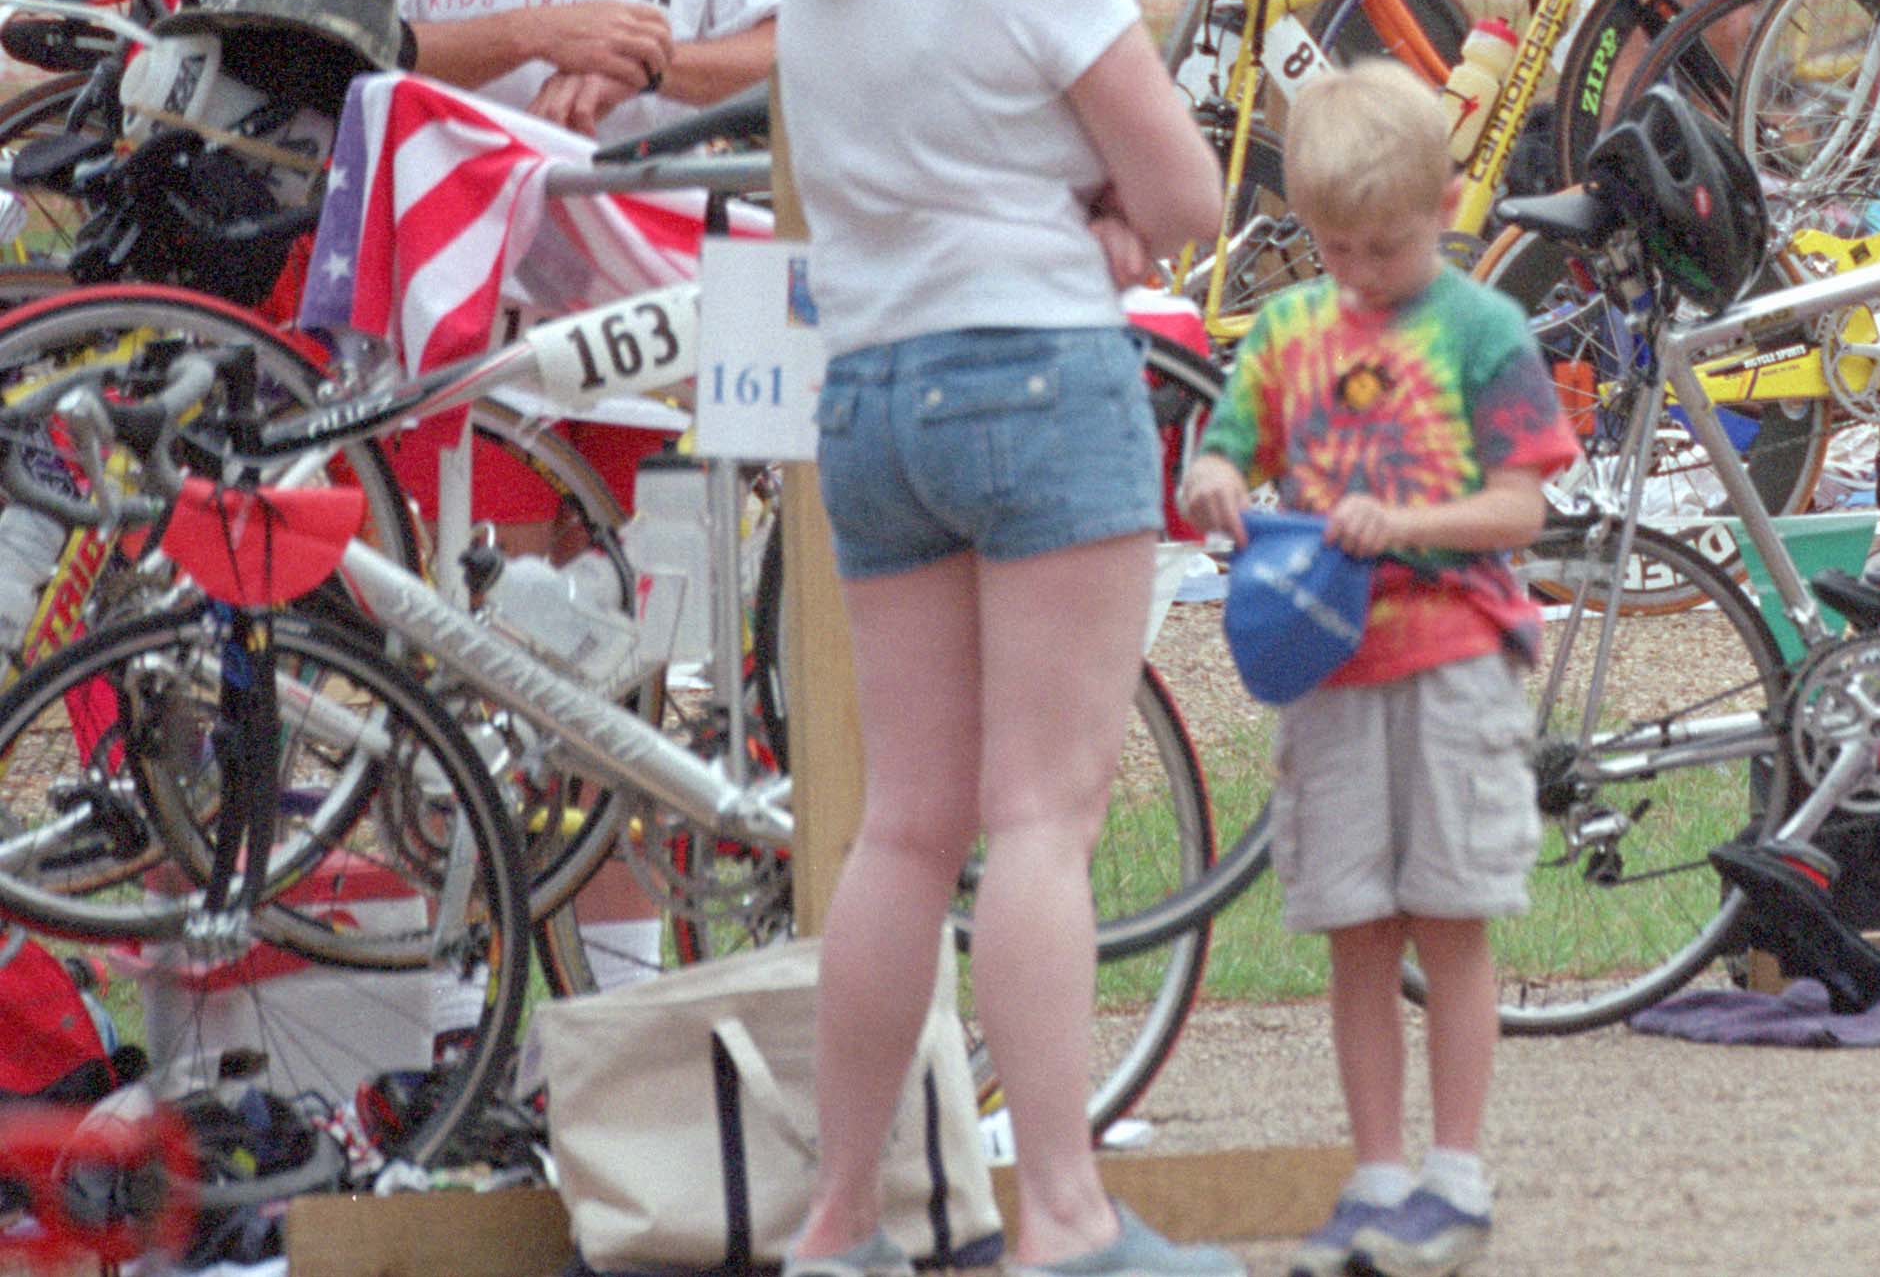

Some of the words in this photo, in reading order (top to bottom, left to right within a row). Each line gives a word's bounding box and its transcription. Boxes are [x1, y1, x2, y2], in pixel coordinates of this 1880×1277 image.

[1581, 26, 1617, 116] ZIPP
[566, 303, 680, 392] 163
[711, 363, 783, 406] 161
